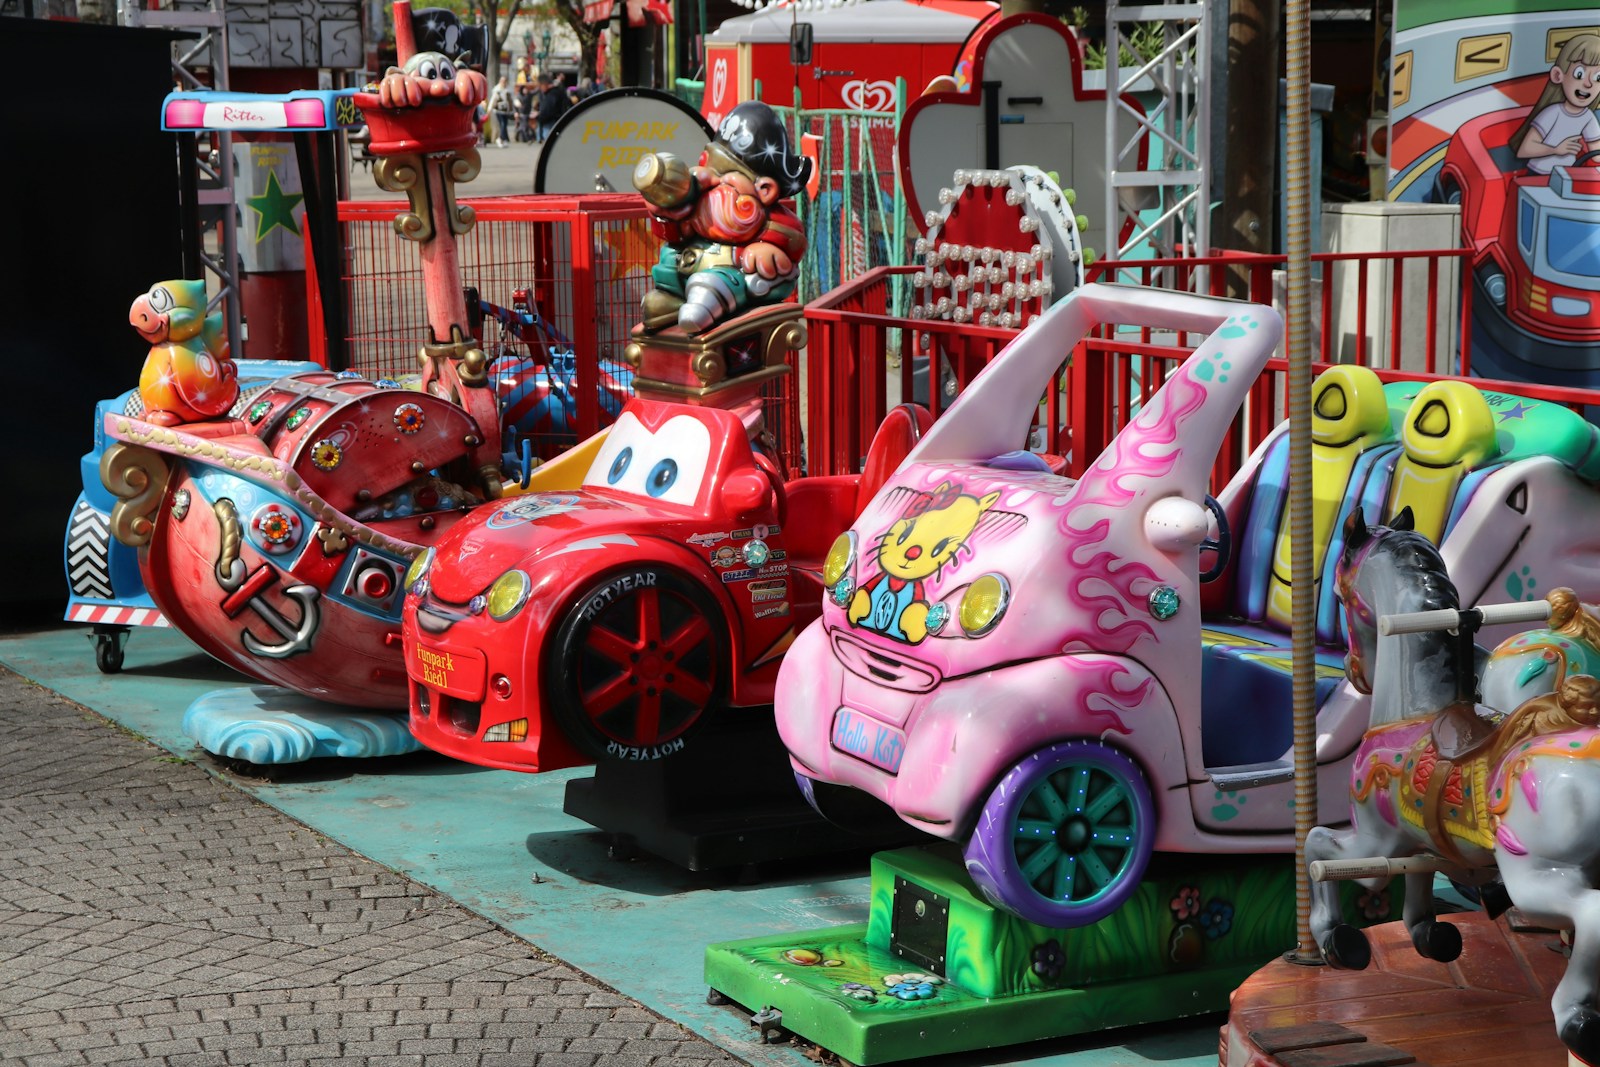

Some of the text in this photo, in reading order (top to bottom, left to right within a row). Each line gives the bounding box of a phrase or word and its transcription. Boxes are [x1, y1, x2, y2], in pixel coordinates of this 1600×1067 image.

[223, 106, 265, 122] Ritter
[581, 120, 680, 145] FUNPARK
[598, 146, 657, 170] RIED
[584, 572, 657, 621] HOTYEAR
[606, 738, 685, 761] HOTYEAR
